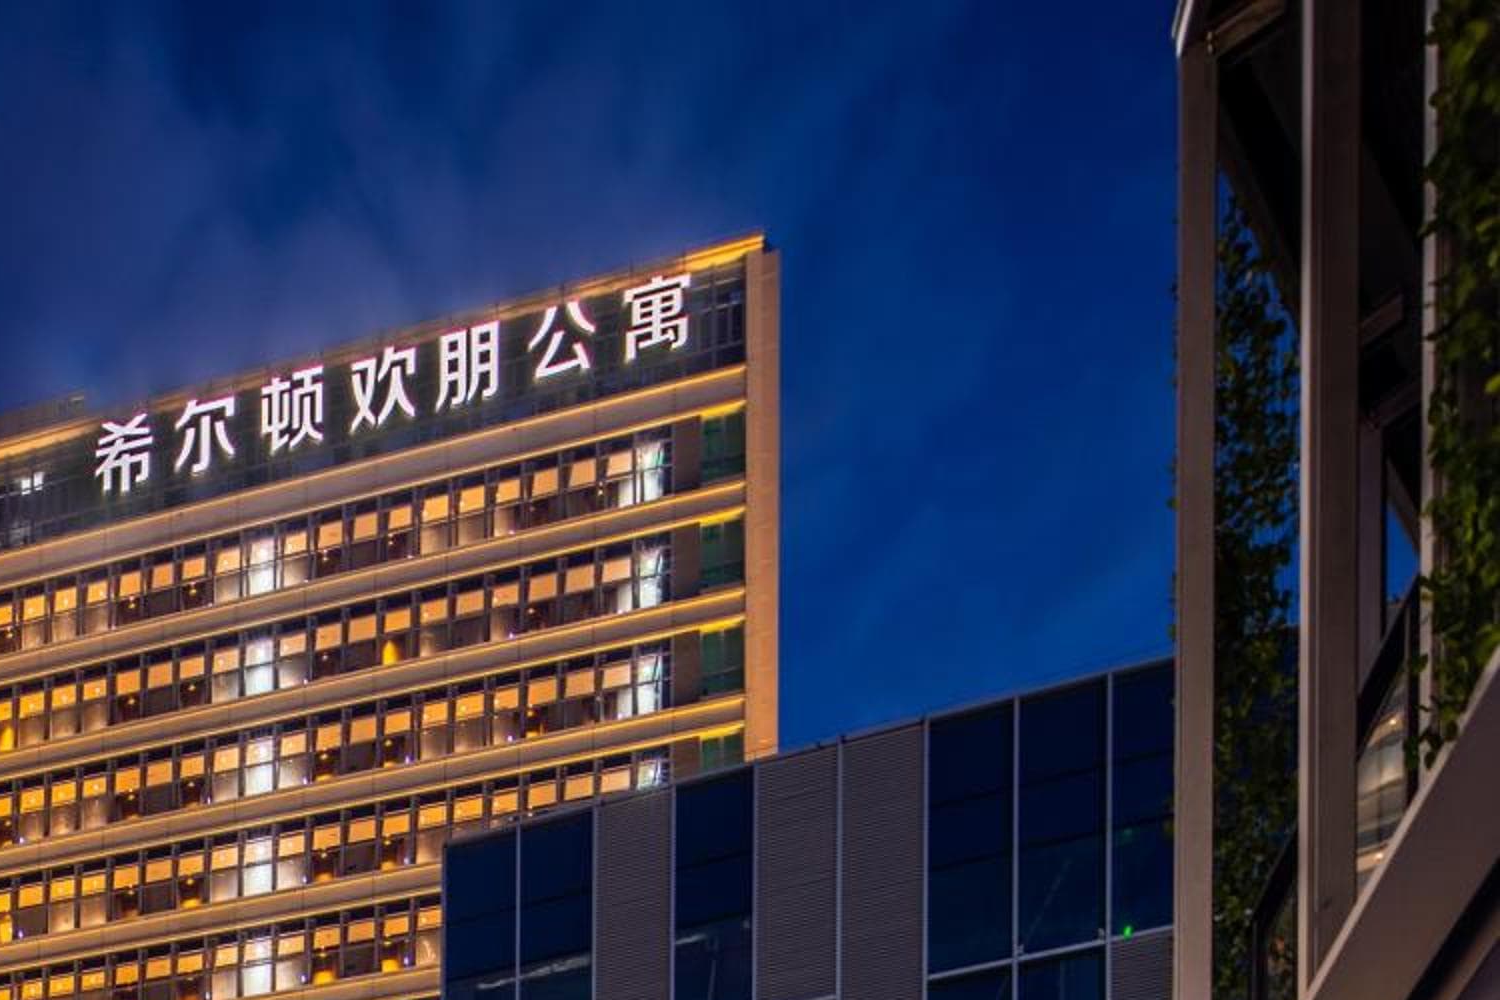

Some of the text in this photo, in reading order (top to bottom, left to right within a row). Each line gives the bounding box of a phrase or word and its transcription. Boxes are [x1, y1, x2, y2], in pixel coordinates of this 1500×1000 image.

[94, 274, 691, 492] 希尔顿欢朋公寓
